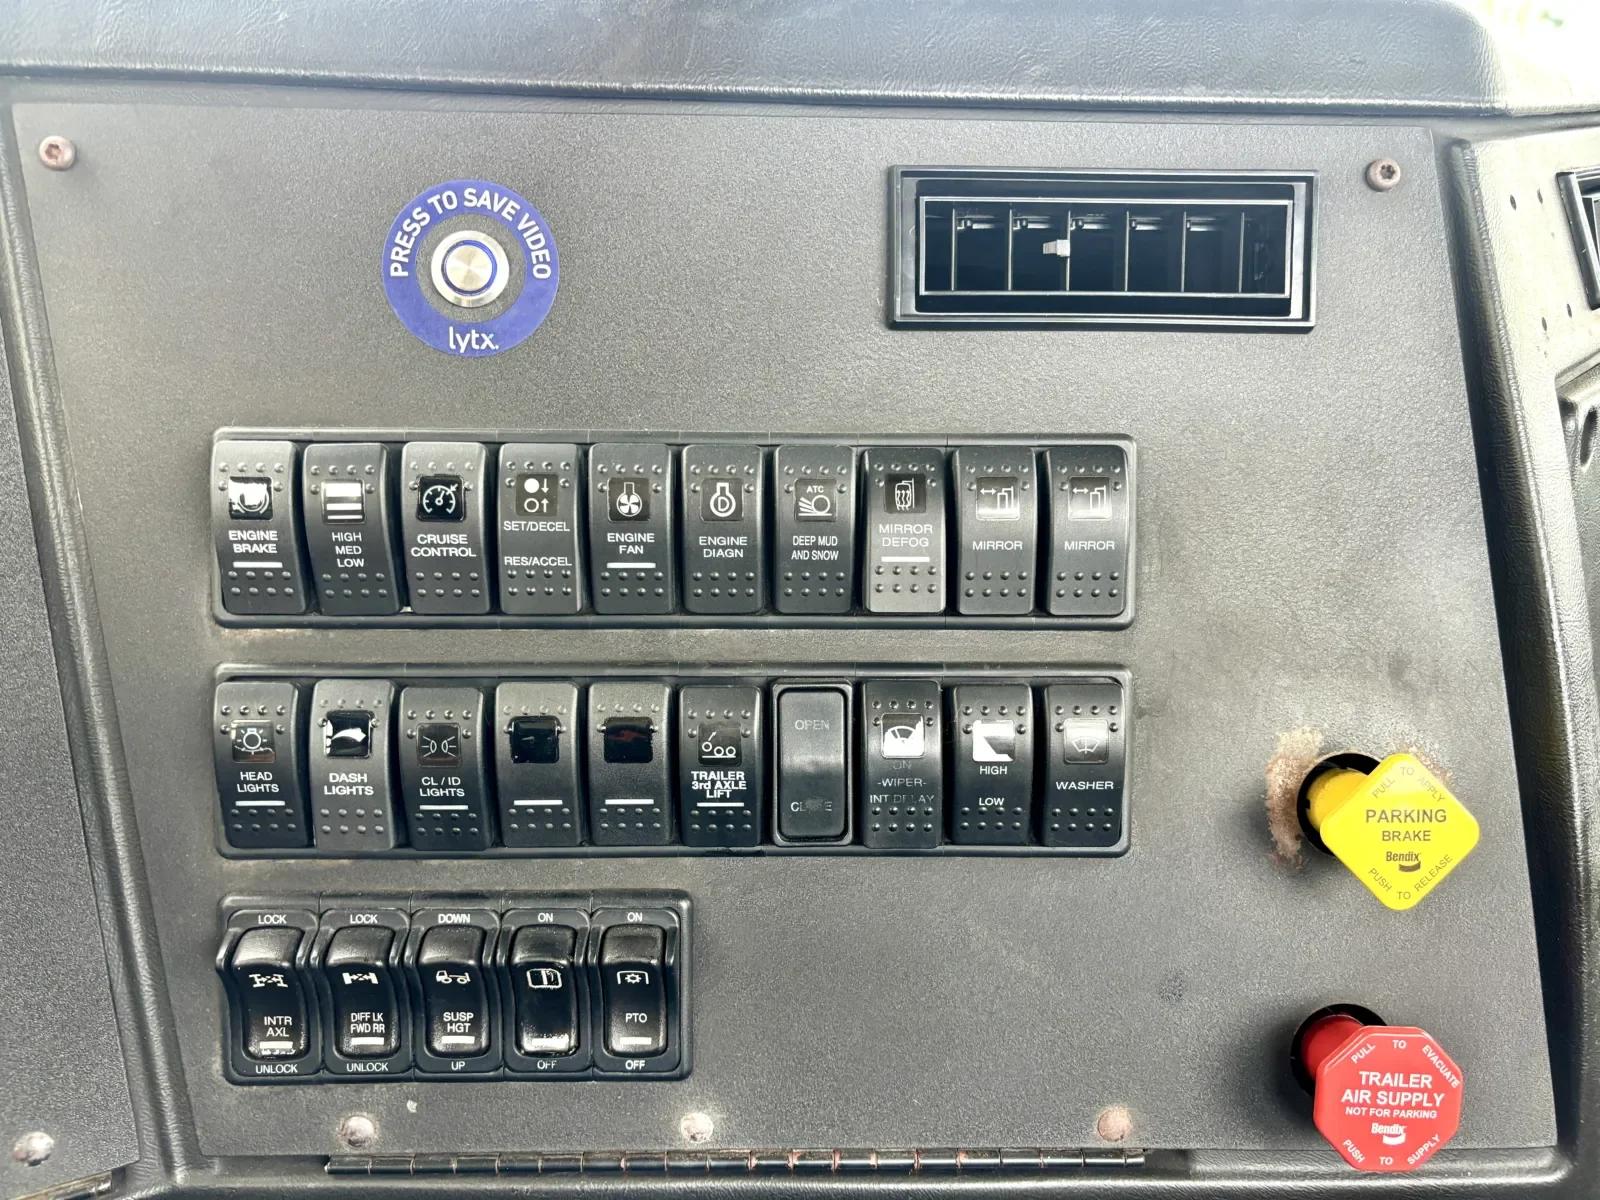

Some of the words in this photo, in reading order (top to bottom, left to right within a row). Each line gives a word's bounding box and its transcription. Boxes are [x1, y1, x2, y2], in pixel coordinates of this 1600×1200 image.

[390, 207, 430, 277] PRESS
[427, 190, 458, 215] TO
[463, 187, 521, 222] SAVE
[517, 213, 551, 279] VIDEO
[807, 485, 824, 493] ATC
[503, 521, 570, 532] SET/DECEL
[879, 523, 933, 534] MIRROR
[228, 530, 278, 541] ENGINE
[332, 532, 362, 542] HIGH
[417, 534, 468, 545] CRUISE
[607, 533, 655, 543] ENGINE
[699, 536, 748, 546] ENGINE
[792, 535, 816, 546] DEEP
[818, 535, 838, 547] MUD
[882, 537, 929, 548] DEFOG
[972, 540, 1023, 550] MIRROR
[1064, 540, 1115, 550] MIRROR
[232, 543, 278, 554] BRAKE
[335, 545, 362, 555] MED
[411, 547, 477, 558] CONTROL
[619, 544, 644, 554] FAN
[703, 548, 744, 558] DIAGN
[791, 549, 810, 560] AND
[811, 549, 839, 561] SNOW
[337, 558, 364, 568] LOW
[504, 556, 572, 567] RES/ACCEL
[794, 719, 830, 730] OPEN
[979, 765, 1008, 775] HIGH
[240, 772, 273, 781] HEAD
[329, 773, 367, 783] DASH
[421, 776, 438, 786] CL
[441, 776, 445, 786] /
[448, 776, 461, 786] ID
[691, 771, 745, 781] TRAILER
[237, 783, 279, 793] LIGHTS
[691, 781, 713, 790] 3rd
[714, 781, 747, 790] AXLE
[1055, 781, 1114, 790] WASHER
[1372, 777, 1396, 799] PULL
[1400, 766, 1415, 776] TO
[1416, 777, 1446, 802] APPLY
[323, 785, 374, 796] LIGHTS
[419, 787, 465, 798] LIGHTS
[706, 789, 732, 799] LIFT
[869, 794, 889, 804] INT
[978, 797, 1005, 806] LOW
[790, 801, 833, 812] CLE
[1365, 809, 1447, 823] PARKING
[1382, 830, 1431, 842] BRAKE
[1386, 851, 1420, 862] Bendix
[1368, 867, 1393, 892] PUSH
[1396, 891, 1411, 900] TO
[1414, 854, 1453, 892] RELEASE
[258, 914, 287, 924] LOCK
[350, 914, 378, 924] LOCK
[438, 914, 471, 924] DOWN
[537, 912, 553, 922] ON
[627, 912, 643, 922] ON
[264, 1016, 292, 1026] INTR
[350, 1012, 371, 1022] DIFF
[372, 1012, 384, 1022] LK
[443, 1012, 474, 1022] SUSP
[625, 1013, 648, 1023] PTO
[266, 1027, 289, 1037] AXL
[350, 1024, 371, 1033] FWD
[372, 1023, 385, 1033] RR
[447, 1023, 471, 1033] HGT
[346, 1062, 388, 1072] UNLOCK
[451, 1061, 465, 1070] UP
[537, 1060, 557, 1070] OFF
[625, 1060, 646, 1070] OFF
[1351, 1043, 1376, 1064] PULL
[1392, 1039, 1407, 1049] TO
[1422, 1045, 1461, 1088] EVACUATE
[255, 1064, 298, 1074] UNLOCK
[1359, 1071, 1432, 1088] TRAILER
[1341, 1089, 1371, 1105] AIR
[1376, 1092, 1445, 1107] SUPPLY
[1345, 1106, 1368, 1116] NOT
[1369, 1107, 1392, 1117] FOR
[1393, 1109, 1437, 1119] PARKING
[1371, 1122, 1405, 1135] Bendix
[1342, 1139, 1366, 1163] PUSH
[1379, 1156, 1393, 1165] TO
[1407, 1134, 1441, 1165] SUPPLY
